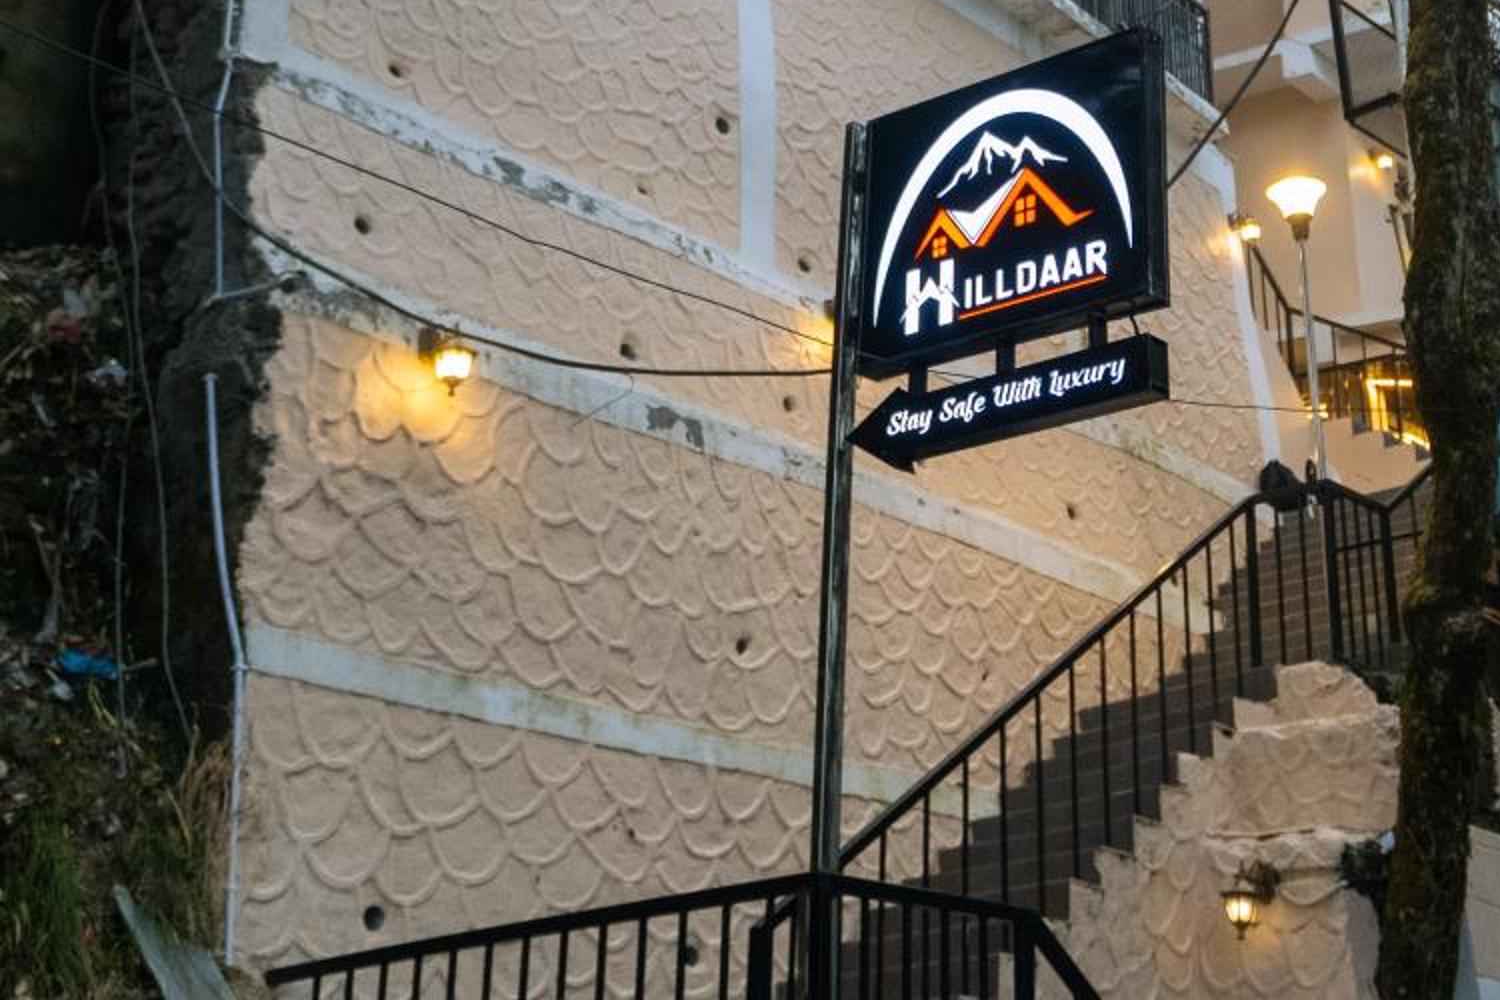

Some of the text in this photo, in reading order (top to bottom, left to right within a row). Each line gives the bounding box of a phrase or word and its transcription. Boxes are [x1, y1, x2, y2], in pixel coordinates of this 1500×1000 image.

[901, 239, 1108, 335] HILLDAAR
[886, 357, 1126, 436] Stay Safe With Luxury
